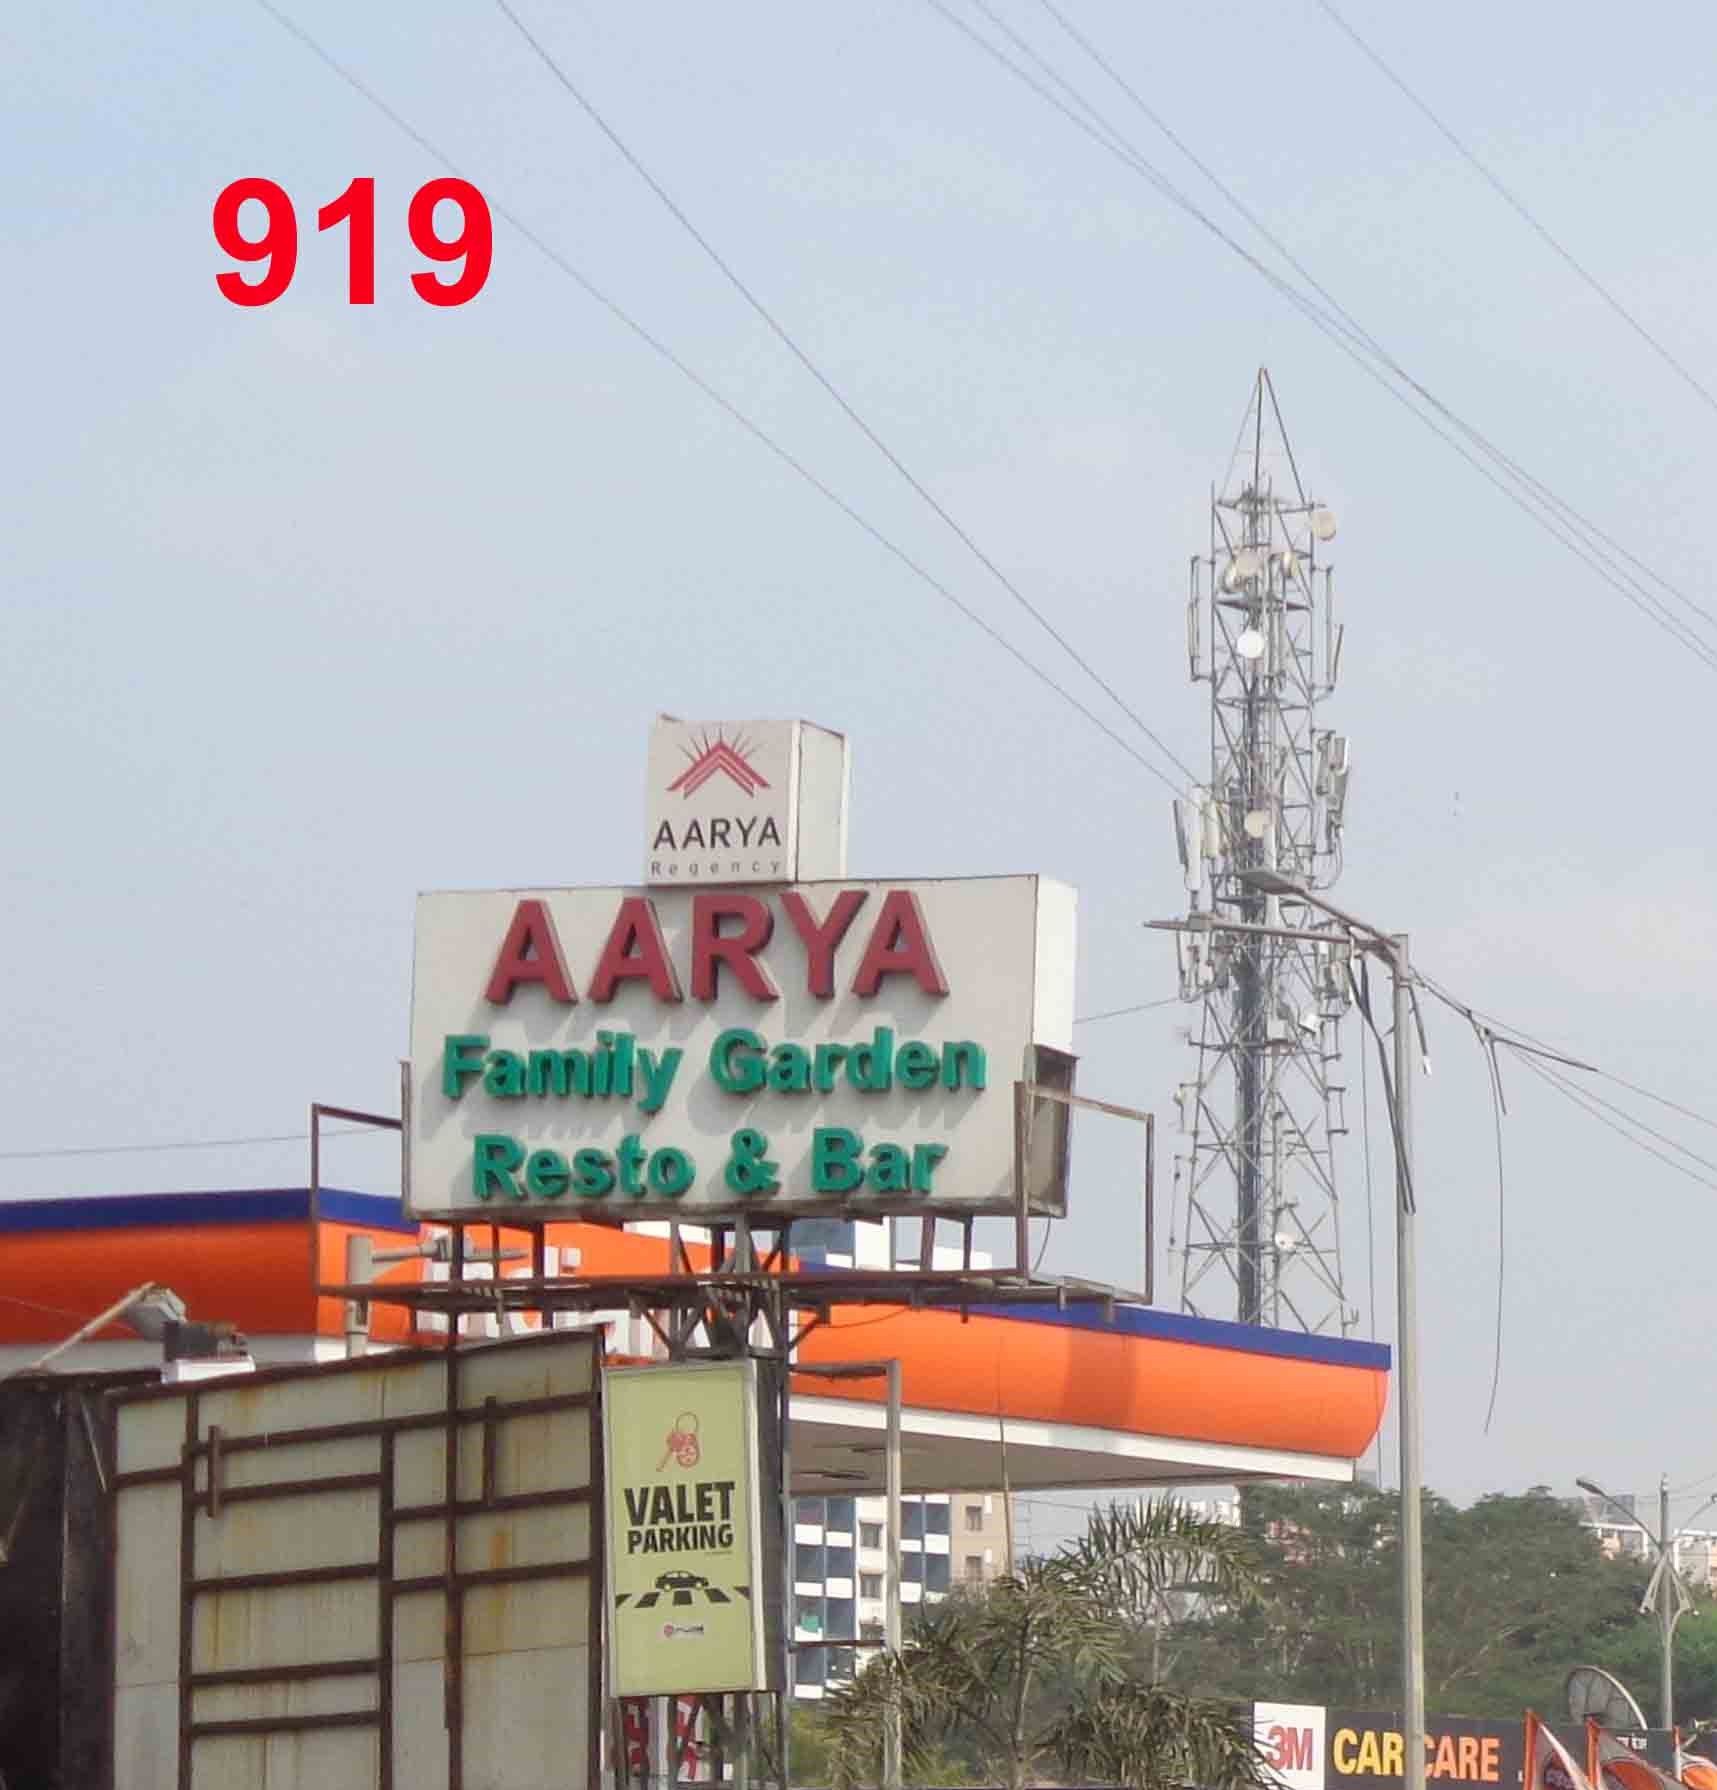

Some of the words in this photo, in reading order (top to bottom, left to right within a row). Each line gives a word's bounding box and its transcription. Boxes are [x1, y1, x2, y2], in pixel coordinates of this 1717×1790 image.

[653, 816, 782, 850] AARYA
[650, 859, 781, 876] Regency
[485, 889, 950, 1003] AARYA
[443, 1031, 683, 1114] Family
[709, 1026, 987, 1096] Garden
[472, 1133, 696, 1199] Resto
[724, 1128, 781, 1196] &
[811, 1127, 950, 1194] Bar
[624, 1482, 736, 1526] VALET
[627, 1524, 734, 1554] PARKING
[1266, 1725, 1313, 1771] 3M
[1333, 1728, 1405, 1777] CAR
